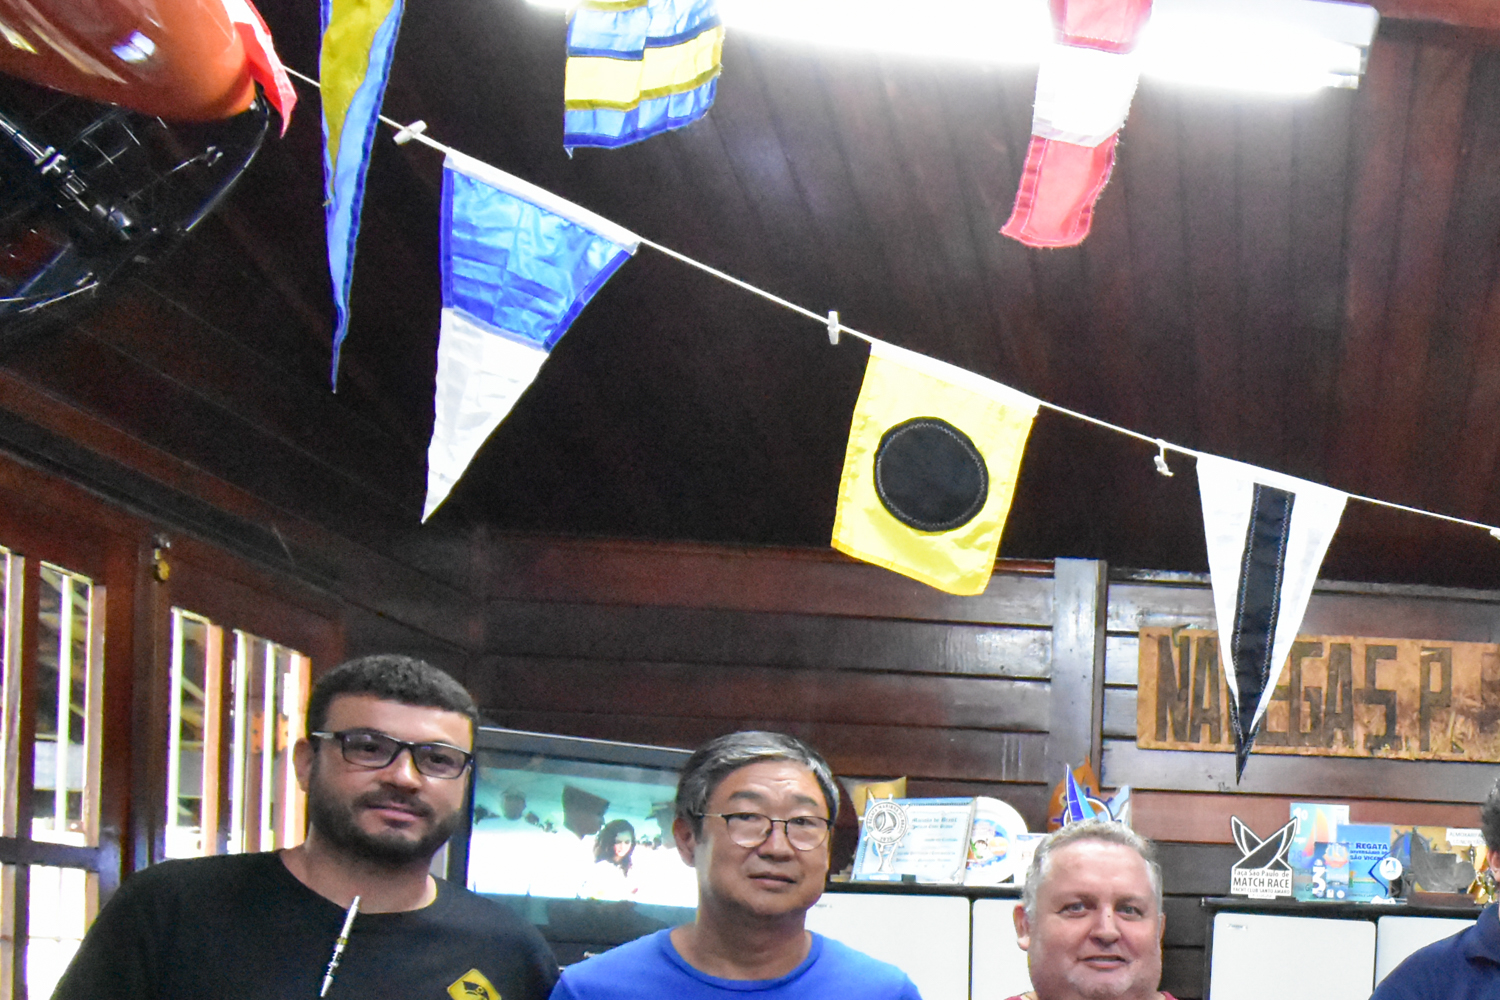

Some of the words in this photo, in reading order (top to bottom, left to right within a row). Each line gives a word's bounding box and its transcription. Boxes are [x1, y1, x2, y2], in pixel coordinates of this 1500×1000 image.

[1356, 842, 1388, 850] REGATA
[1233, 878, 1264, 887] MATCH
[1268, 879, 1289, 888] RACE
